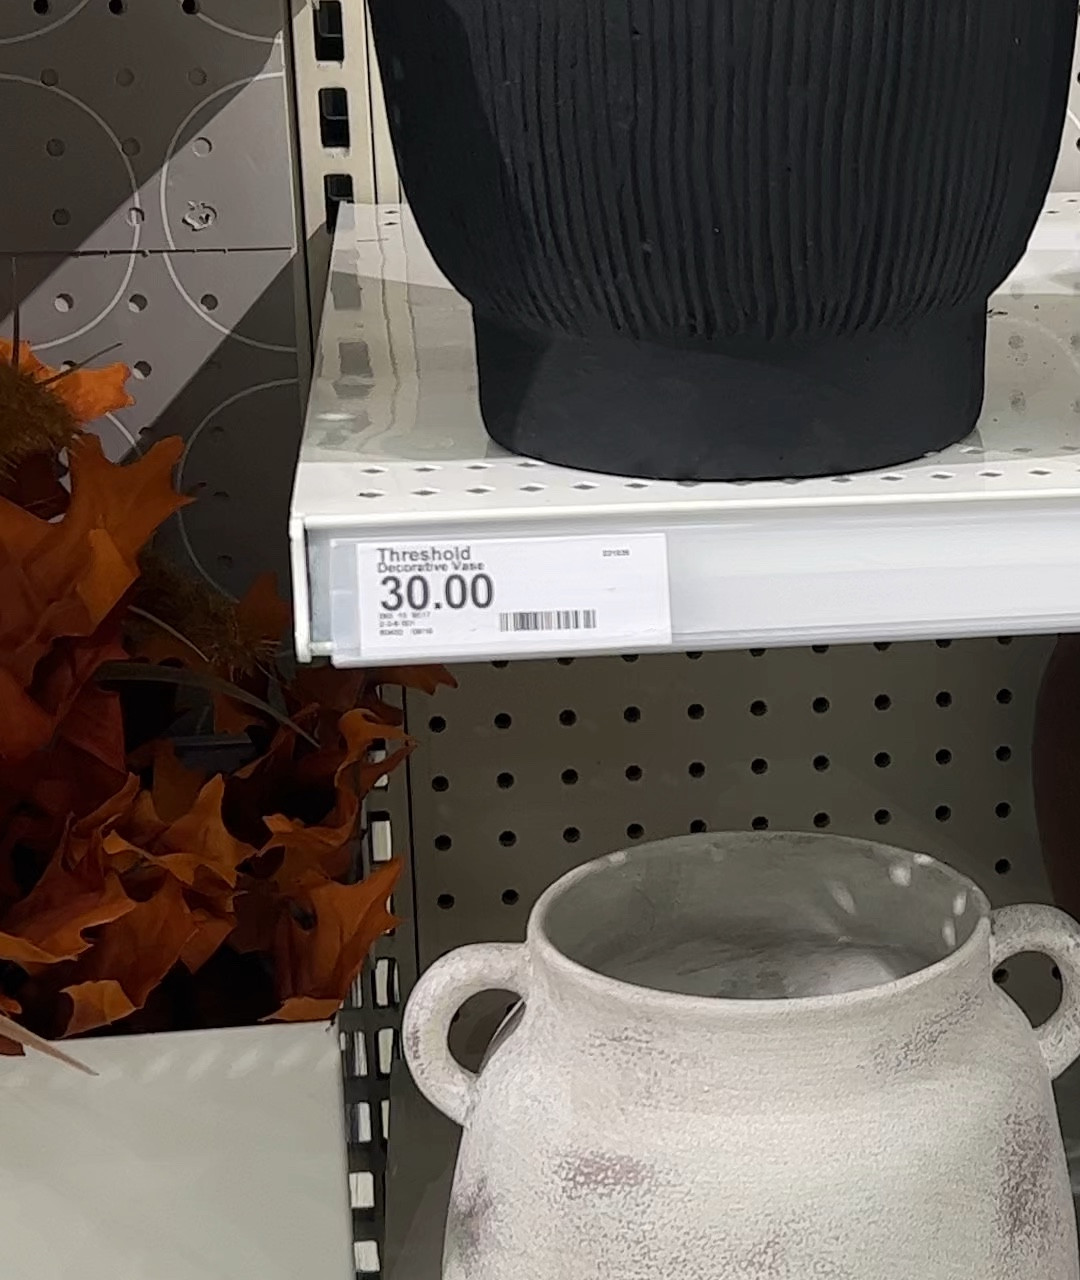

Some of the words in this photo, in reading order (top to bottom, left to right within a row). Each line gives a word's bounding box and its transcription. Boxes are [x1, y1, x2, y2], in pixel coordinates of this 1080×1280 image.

[376, 546, 471, 563] Threshold
[377, 562, 449, 573] Decorative
[452, 560, 485, 571] Vase
[380, 573, 494, 611] 30.00
